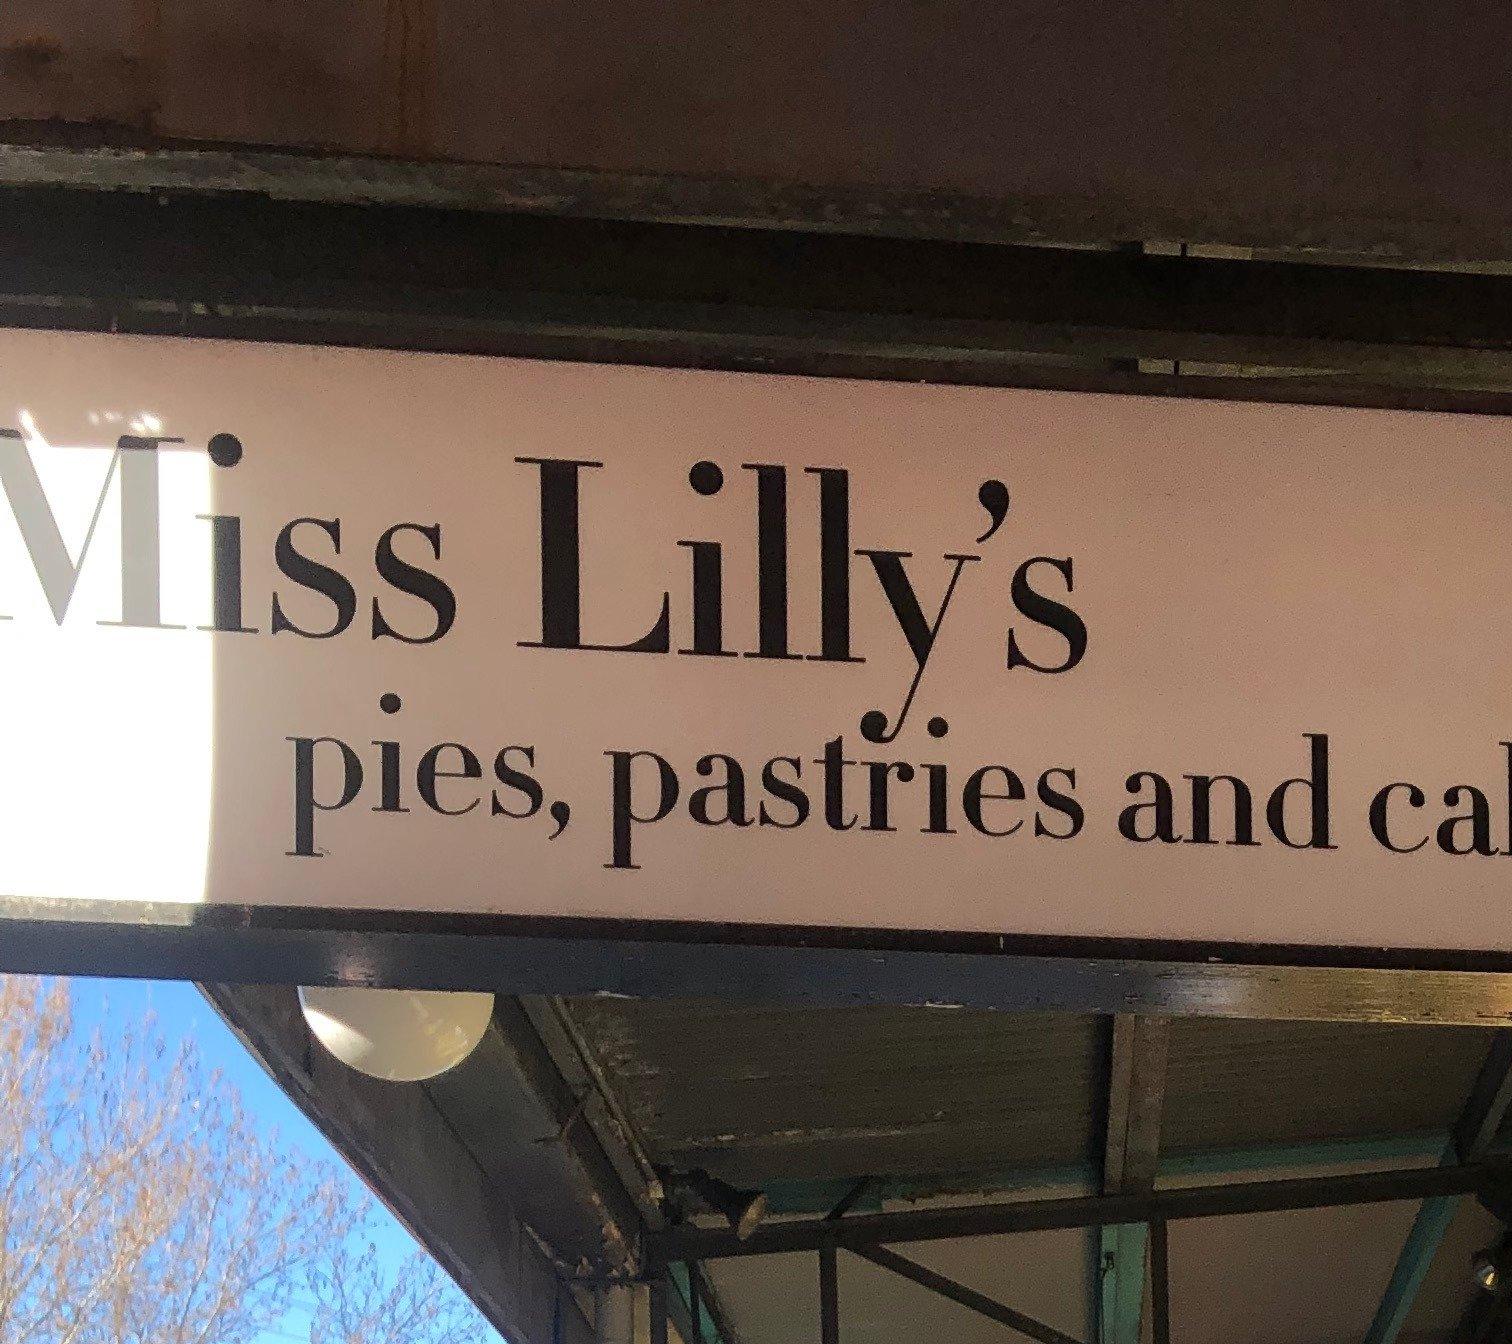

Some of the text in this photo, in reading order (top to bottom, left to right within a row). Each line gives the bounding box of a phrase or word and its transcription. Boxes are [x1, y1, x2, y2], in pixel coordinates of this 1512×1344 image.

[0, 428, 1088, 744] Miss Lilly's
[284, 692, 572, 858] pies,
[602, 716, 1086, 870] pastries
[1117, 733, 1338, 849] and
